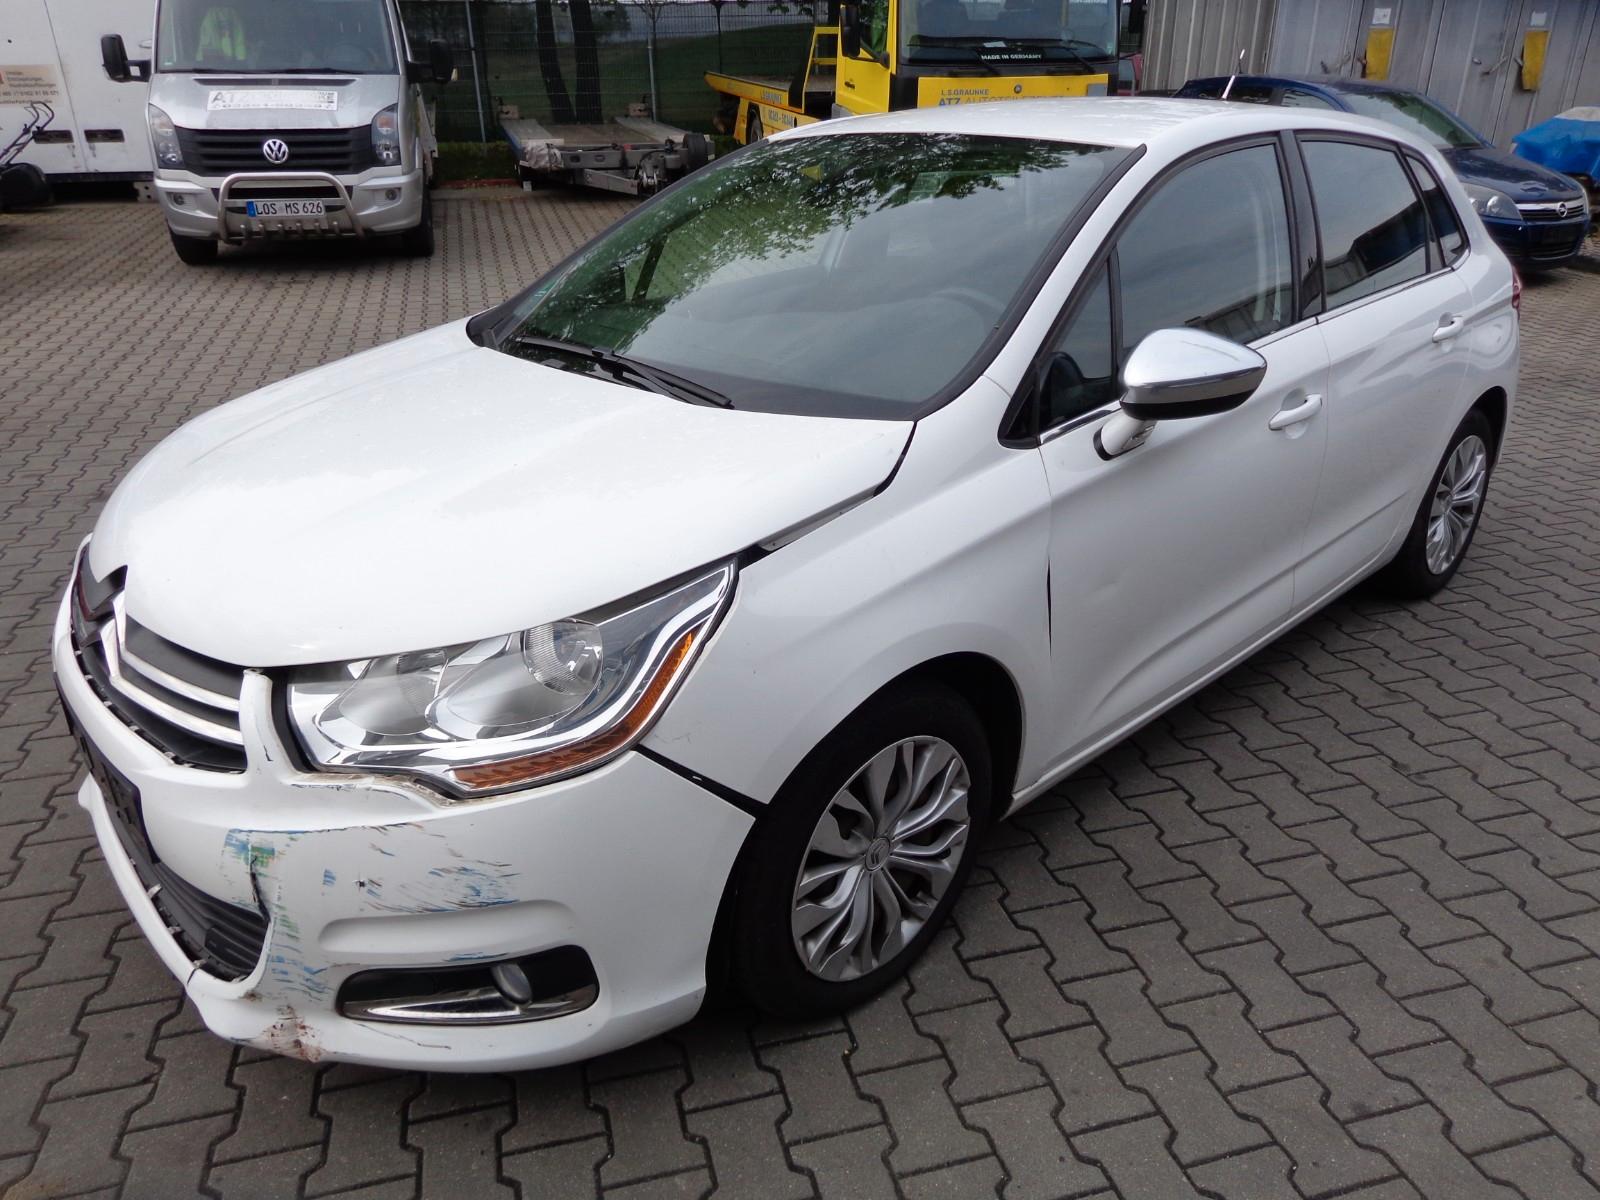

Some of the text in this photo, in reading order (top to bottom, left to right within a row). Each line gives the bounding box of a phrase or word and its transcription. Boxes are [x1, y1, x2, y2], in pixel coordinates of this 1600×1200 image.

[256, 201, 323, 215] LOS MS 626
